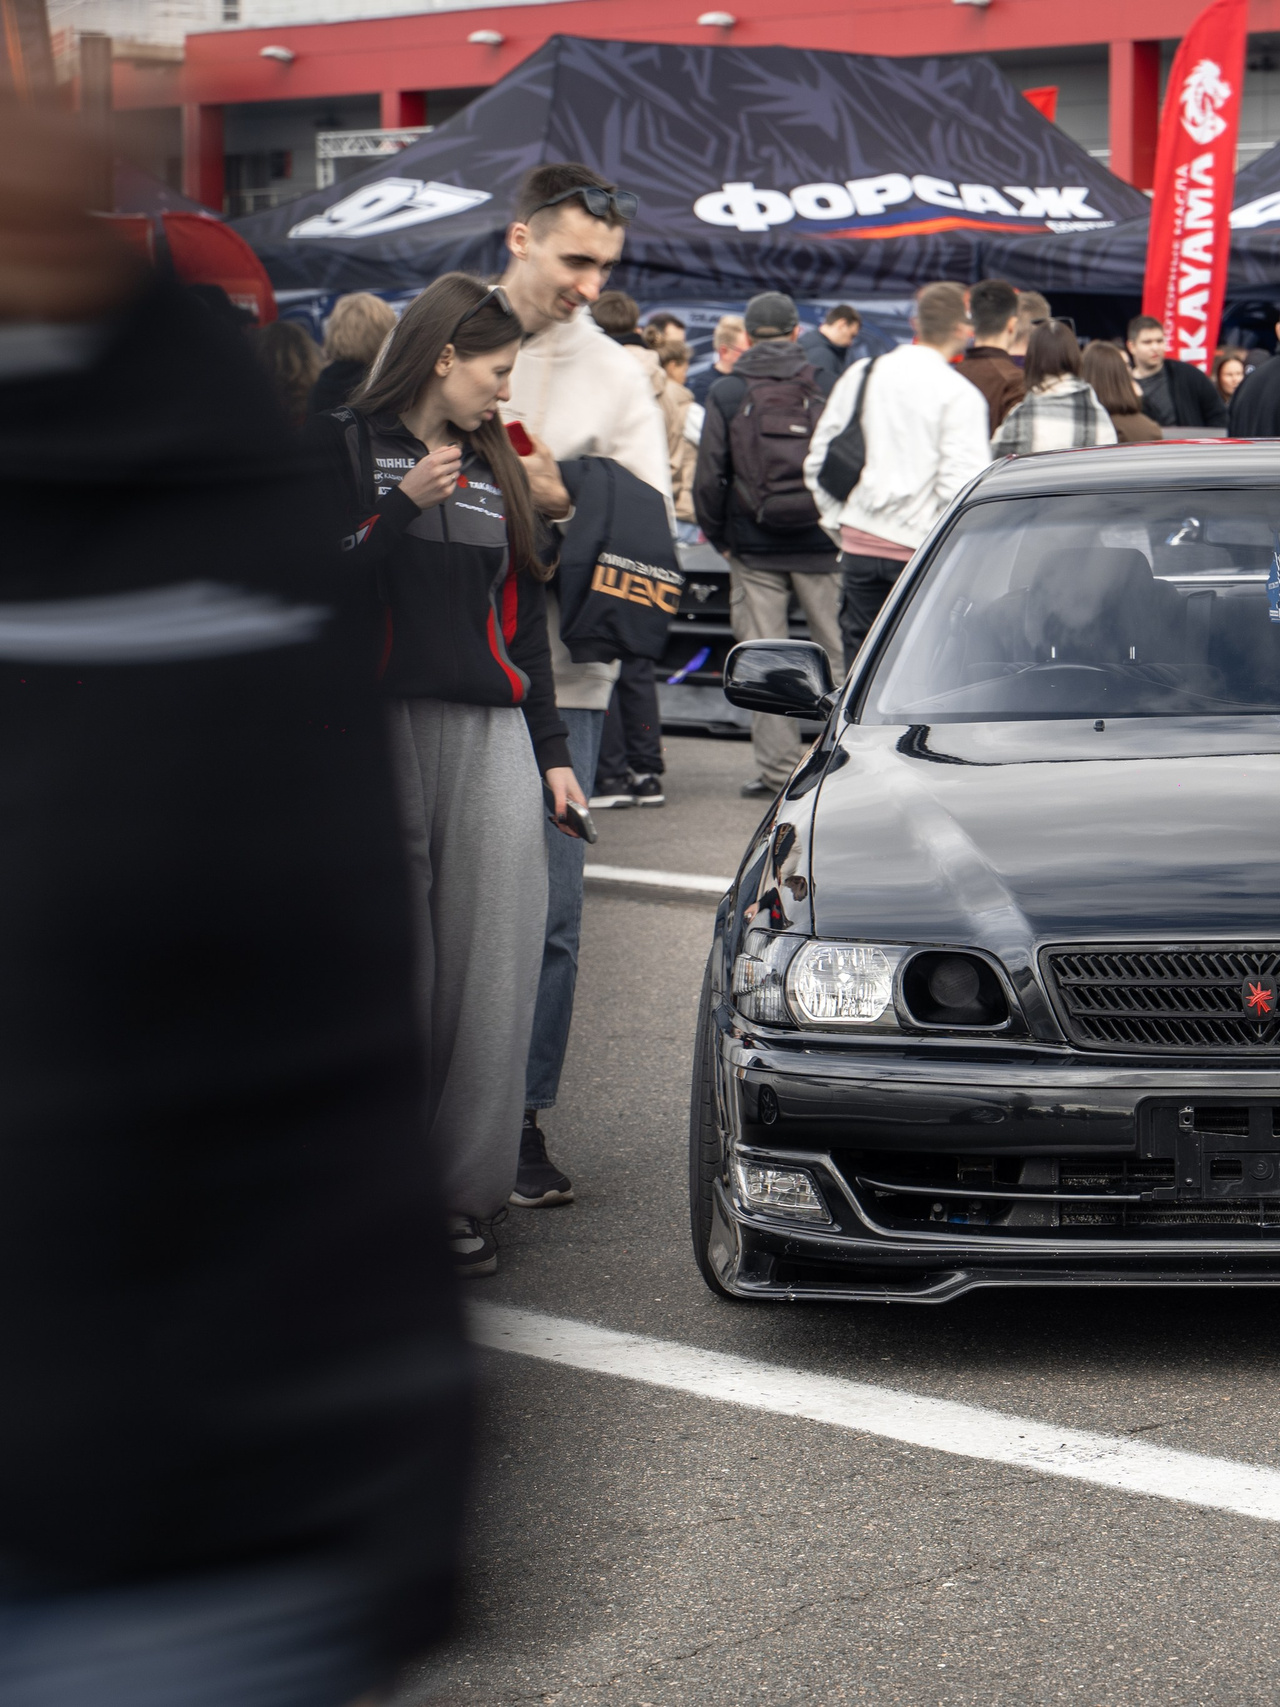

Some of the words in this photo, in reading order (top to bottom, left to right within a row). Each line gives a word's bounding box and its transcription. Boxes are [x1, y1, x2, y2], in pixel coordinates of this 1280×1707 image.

[693, 172, 1104, 232] ФОРСАЖ
[1178, 152, 1215, 373] KAYAMA
[375, 457, 416, 469] MAHLE
